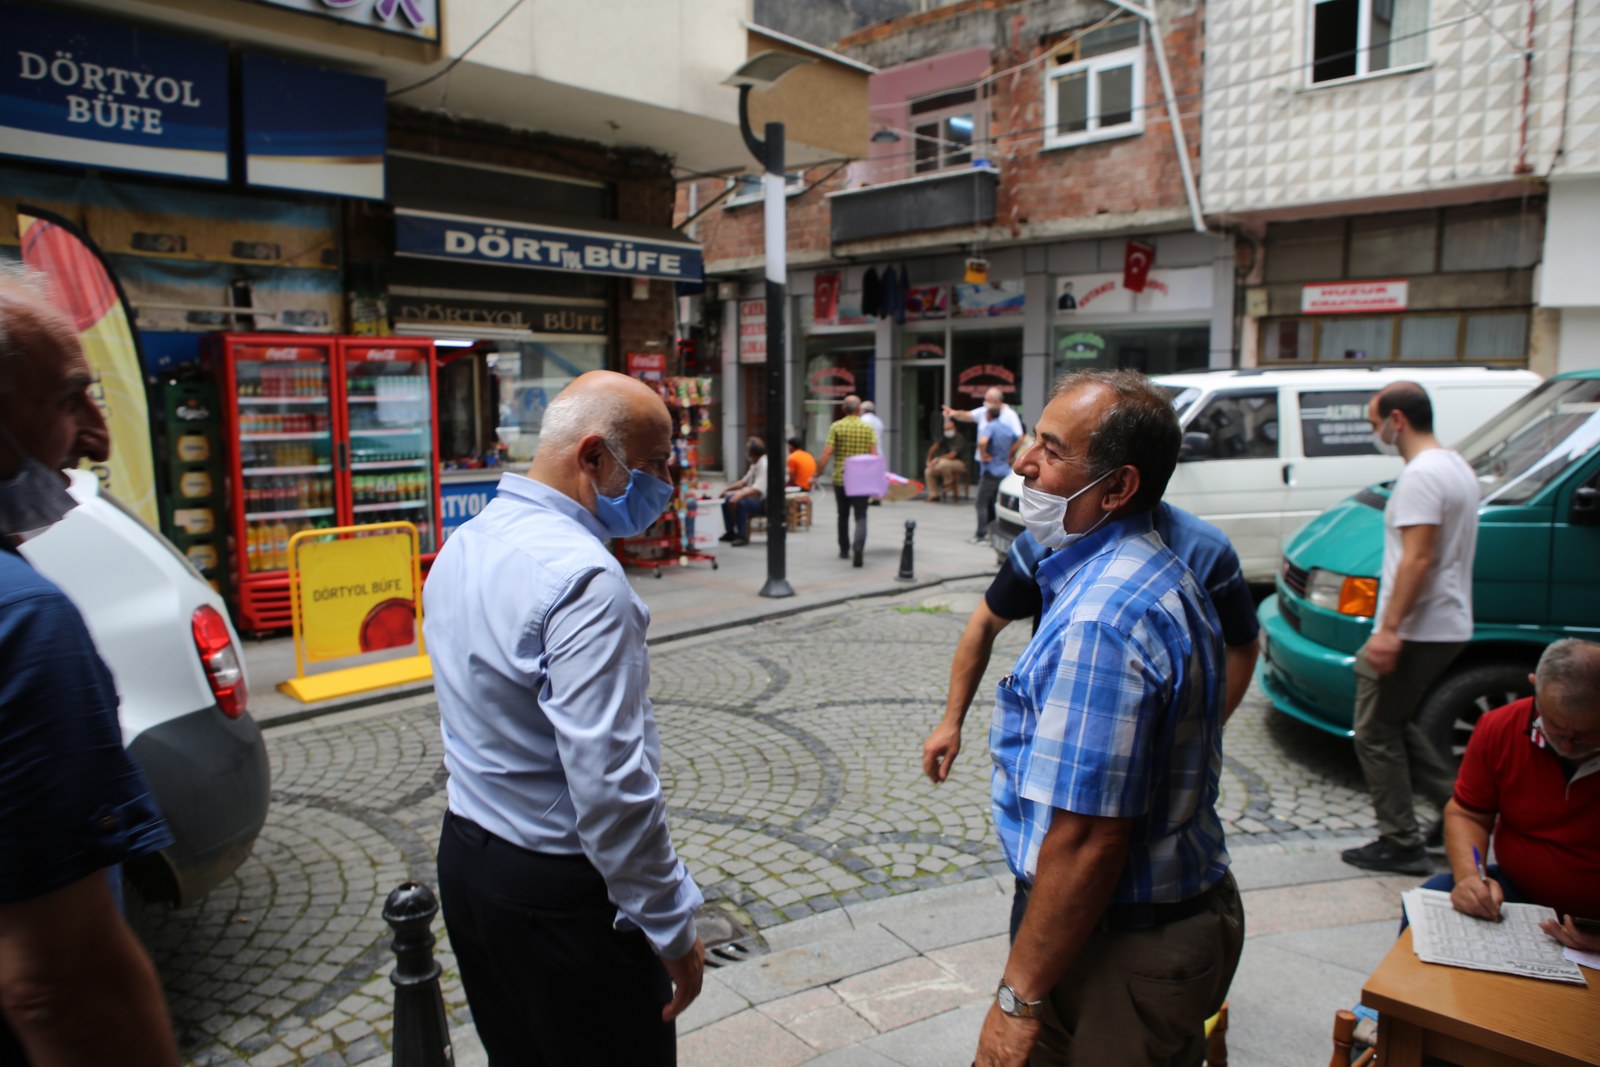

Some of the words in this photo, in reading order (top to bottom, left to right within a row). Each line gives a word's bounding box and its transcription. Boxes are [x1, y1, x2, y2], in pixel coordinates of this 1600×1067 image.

[18, 51, 200, 107] DÖRTYOL
[67, 94, 163, 135] BÜFE
[445, 228, 568, 263] DÖRT
[584, 242, 681, 275] BÜFE
[402, 304, 531, 326] DÖRTYOL
[544, 310, 606, 331] BÜFE
[313, 582, 368, 602] DÖRTYOL
[372, 577, 402, 594] BÜFE
